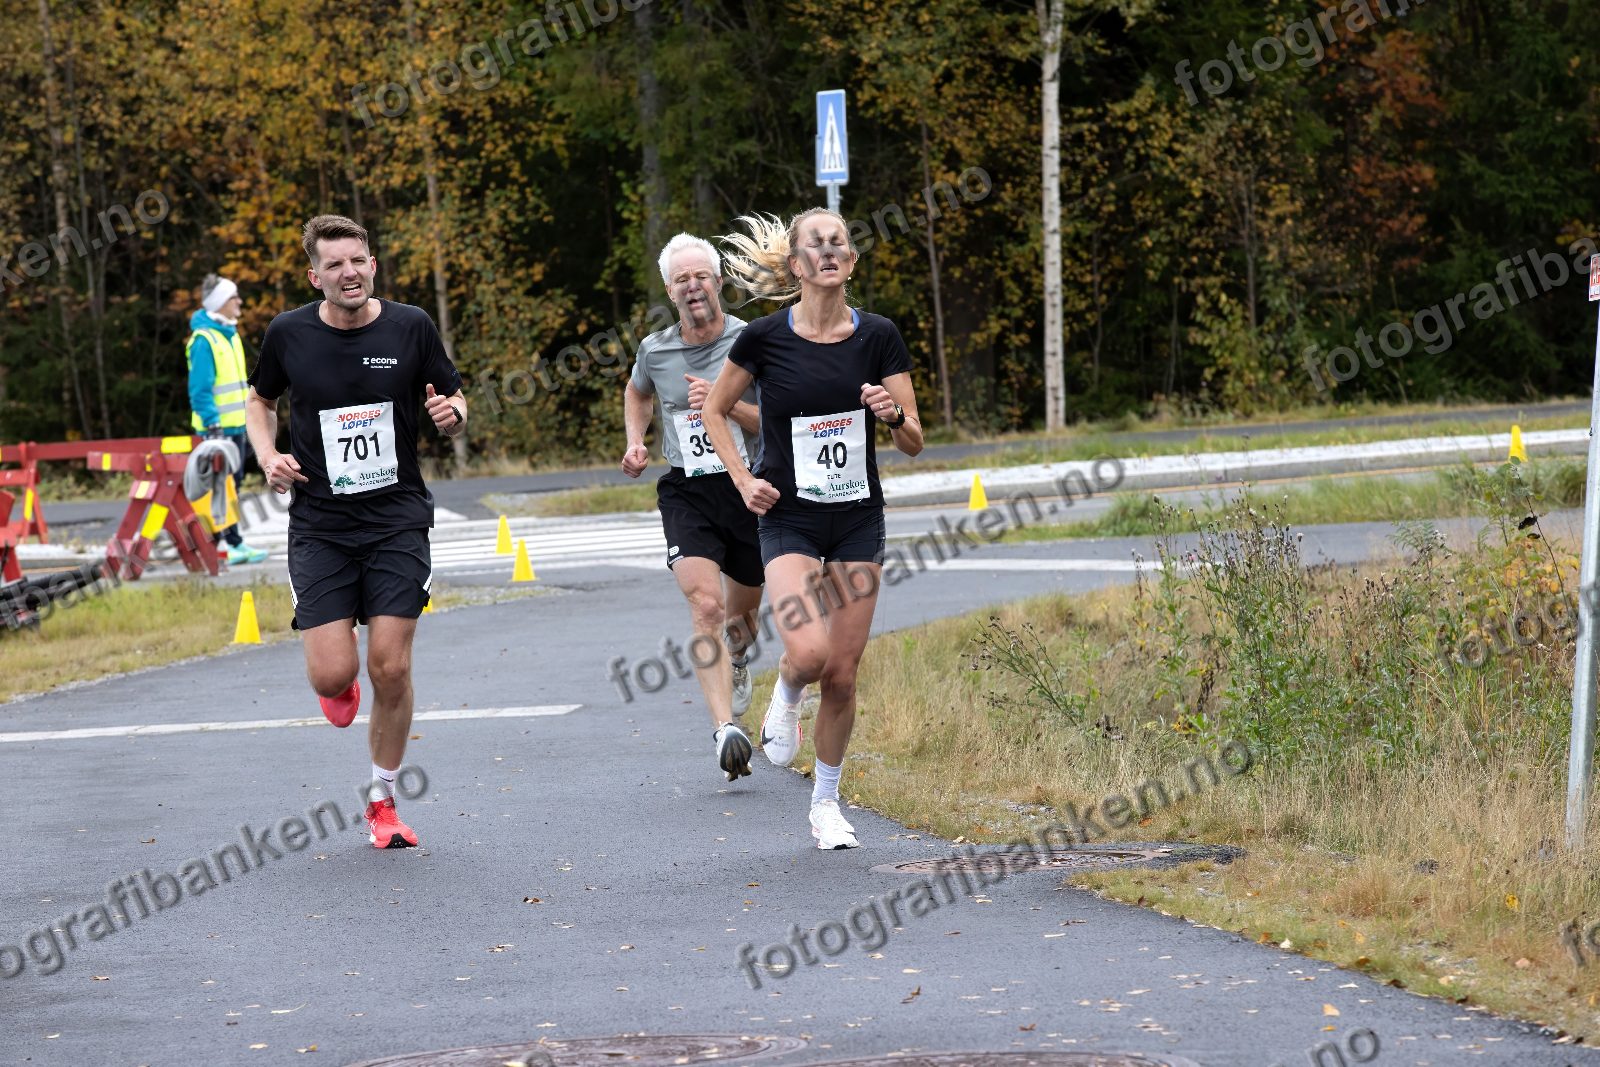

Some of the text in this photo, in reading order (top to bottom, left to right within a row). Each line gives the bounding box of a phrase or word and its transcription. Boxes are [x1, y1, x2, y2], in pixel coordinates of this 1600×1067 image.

[370, 357, 398, 365] econa
[336, 409, 381, 422] NORGES
[687, 412, 702, 422] NO
[342, 418, 375, 430] LØPET
[690, 419, 702, 428] LØ
[808, 417, 853, 431] NORGES
[813, 427, 846, 438] LØPET
[337, 431, 381, 463] 701
[816, 441, 847, 469] 40
[358, 467, 396, 481] Aurskog
[828, 479, 866, 492] Aurskog
